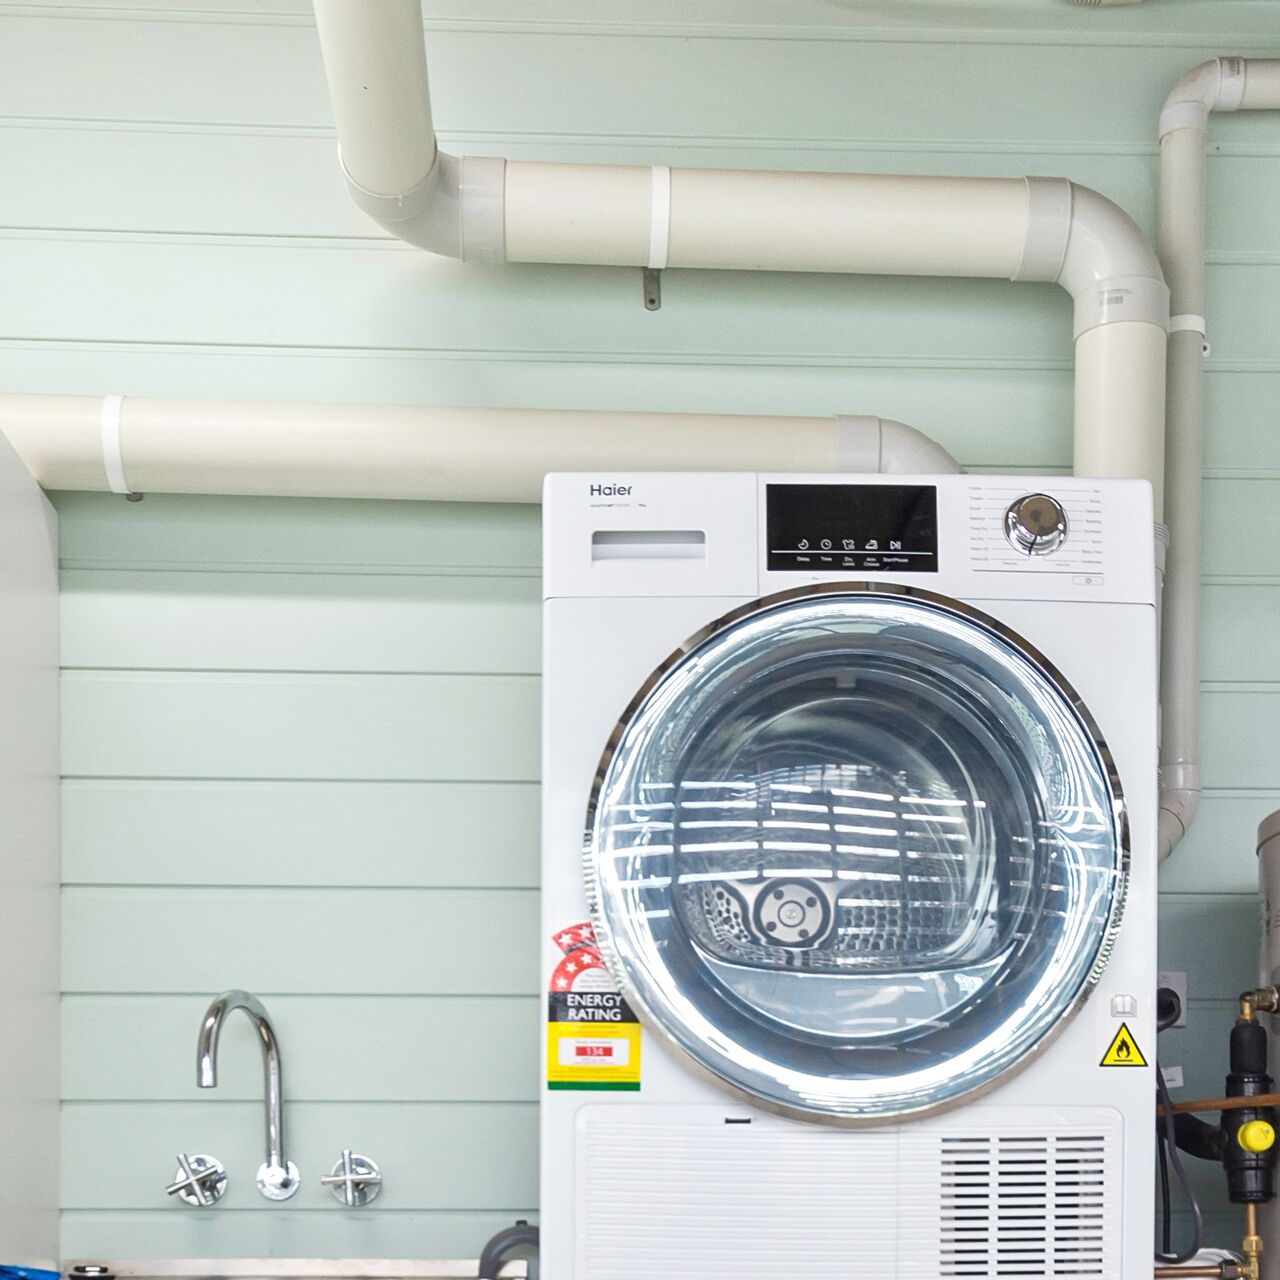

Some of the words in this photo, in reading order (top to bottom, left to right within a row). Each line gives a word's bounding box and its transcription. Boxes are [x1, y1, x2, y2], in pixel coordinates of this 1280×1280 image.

[590, 483, 633, 496] Haier
[567, 994, 622, 1006] ENERGY
[568, 1008, 621, 1020] RATING
